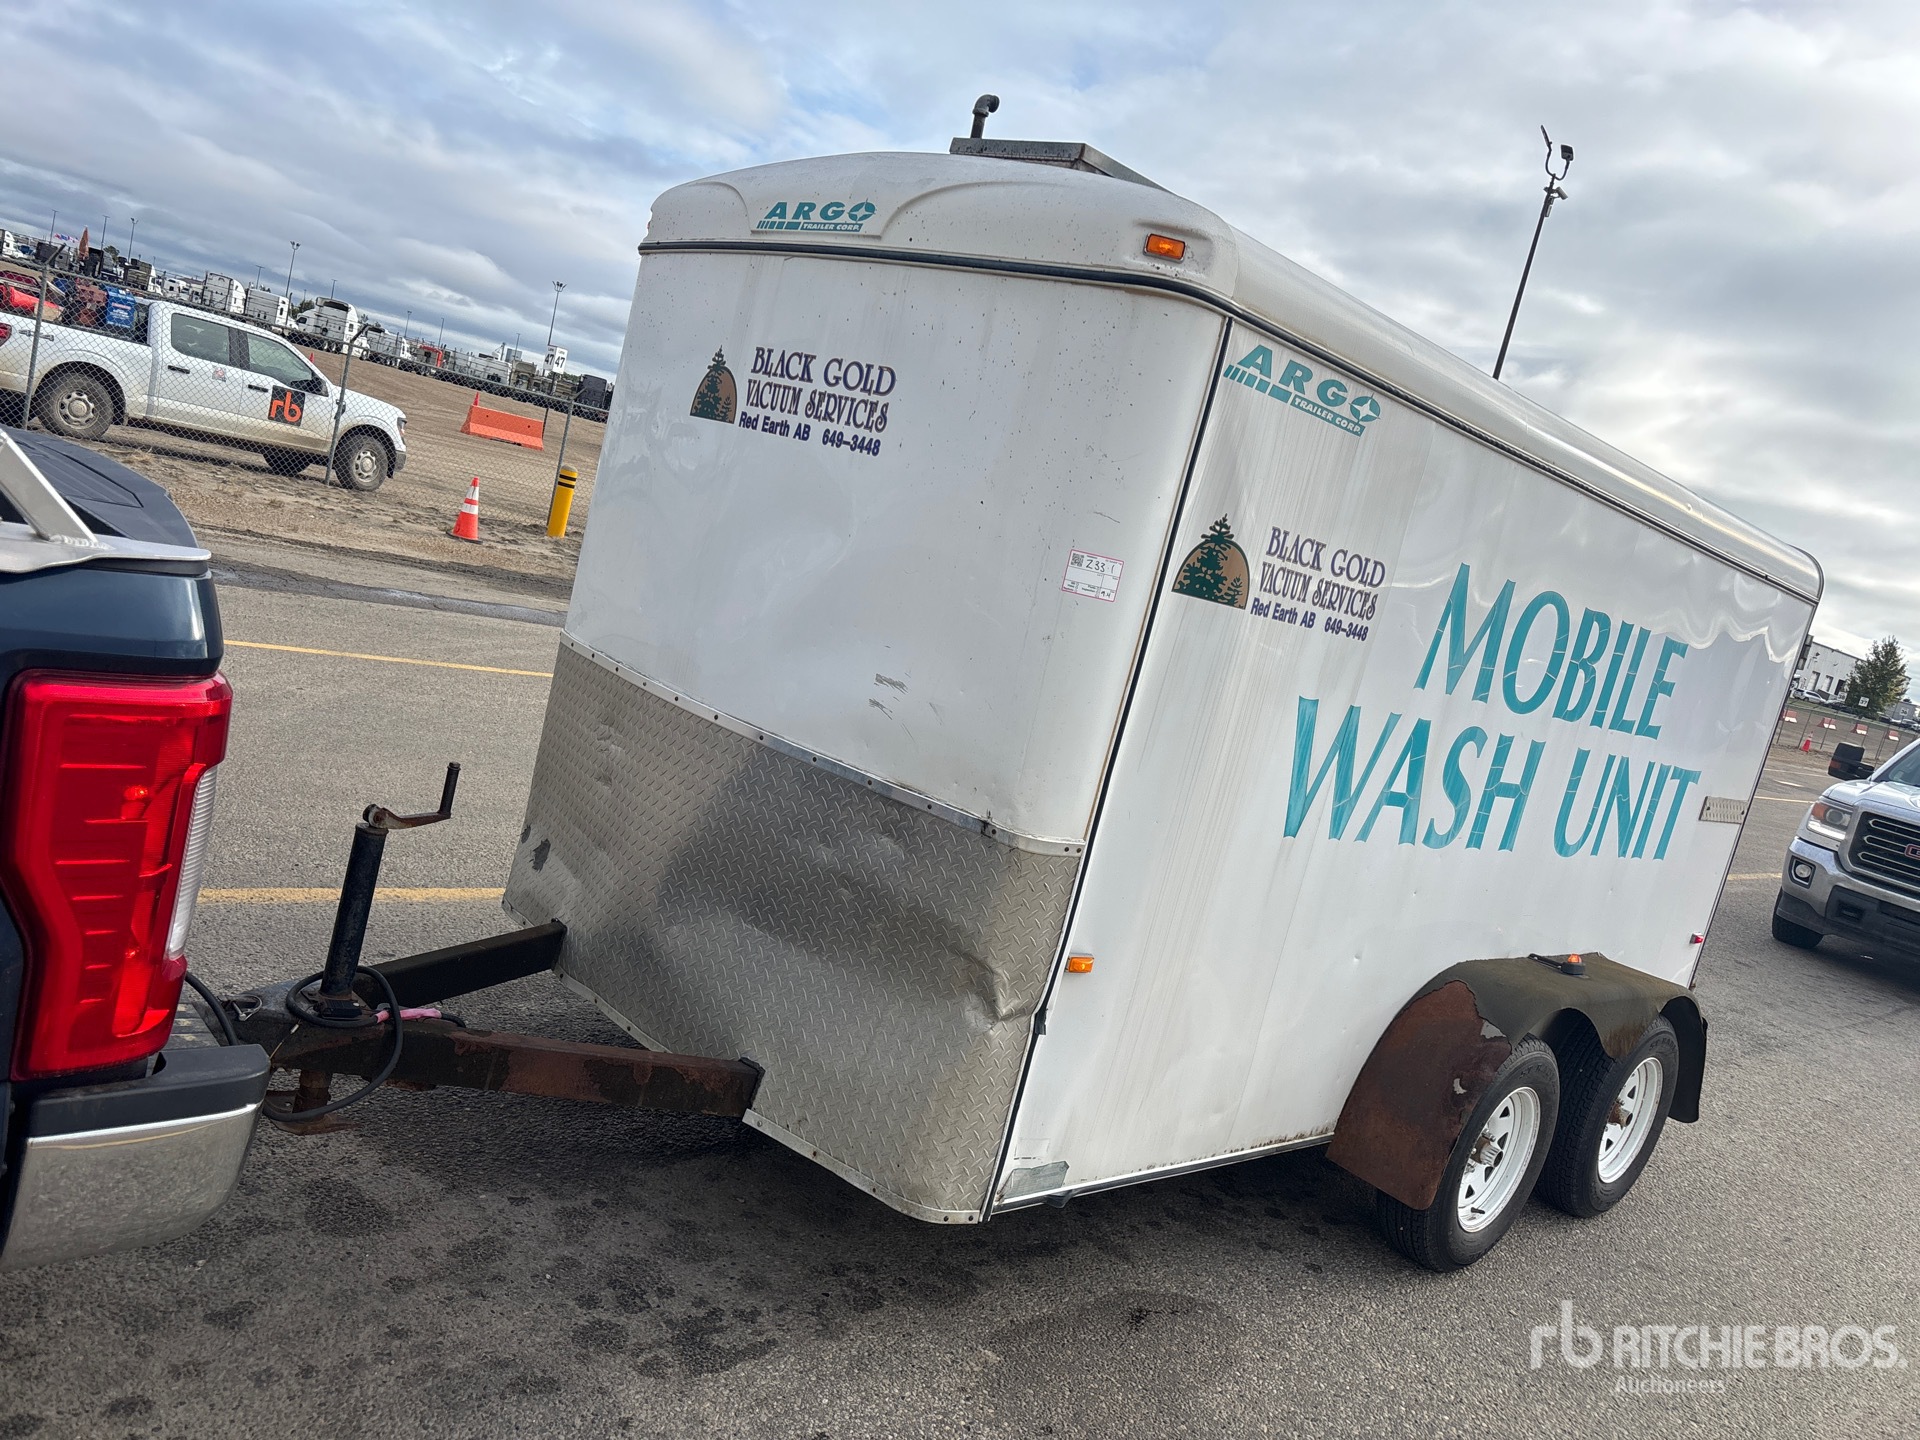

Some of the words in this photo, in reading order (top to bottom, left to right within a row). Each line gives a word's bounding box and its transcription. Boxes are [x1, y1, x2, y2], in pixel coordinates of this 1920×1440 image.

[764, 201, 876, 222] ARGO
[545, 353, 554, 365] 47
[555, 356, 565, 368] 47
[751, 347, 817, 383] BLACK
[823, 358, 897, 397] GOLD
[1237, 344, 1381, 422] ARGO
[270, 391, 302, 422] rb
[746, 379, 803, 416] VACUUM
[804, 389, 889, 434] SERVICES
[1294, 396, 1334, 421] TRAILER
[738, 411, 758, 431] Red
[761, 416, 790, 438] Earth
[793, 423, 811, 441] AB
[822, 428, 881, 457] 649-3448
[1266, 526, 1327, 572] BLACK
[1330, 549, 1386, 588] GOLD
[1259, 561, 1312, 603] VACUUM
[1311, 577, 1379, 621] SERVICES
[1250, 597, 1270, 618] Red
[1272, 602, 1299, 626] Earth
[1300, 610, 1317, 629] AB
[1324, 616, 1369, 642] 649-3448
[1413, 562, 1689, 741] MOBILE
[1283, 695, 1547, 852] WASH
[1553, 747, 1702, 861] UNIT
